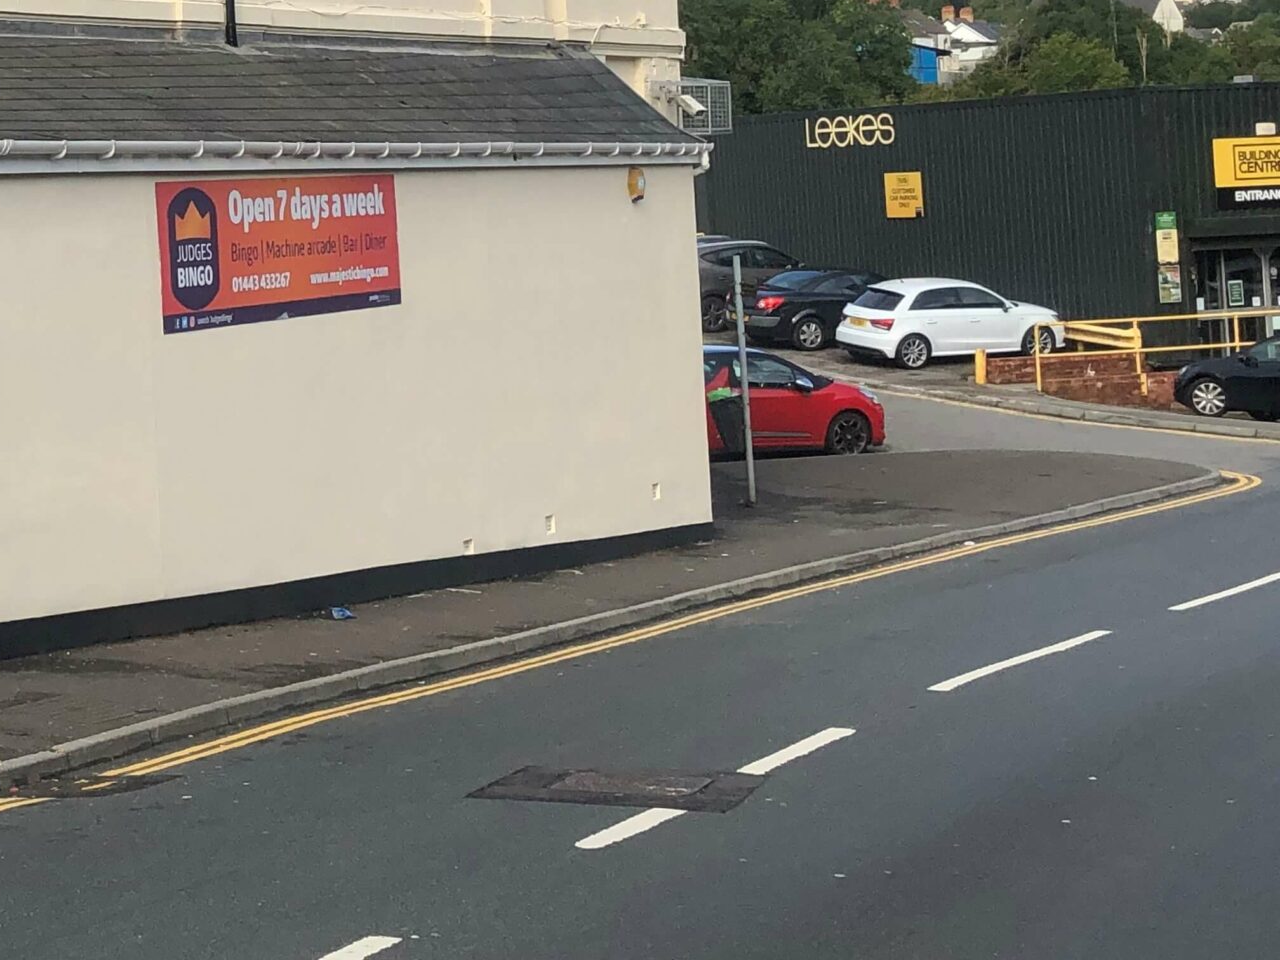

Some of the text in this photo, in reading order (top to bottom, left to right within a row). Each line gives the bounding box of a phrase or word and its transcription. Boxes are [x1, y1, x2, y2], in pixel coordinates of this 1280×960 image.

[1235, 188, 1280, 201] ENTRAN
[228, 183, 385, 233] Open 7 days a week
[177, 243, 213, 262] JUDGES
[231, 233, 387, 267] Bingo Machine arcade Bar Diner
[178, 265, 213, 288] BINGO
[232, 272, 291, 292] 01443 433267
[311, 265, 389, 286] www.majesticbingo.com
